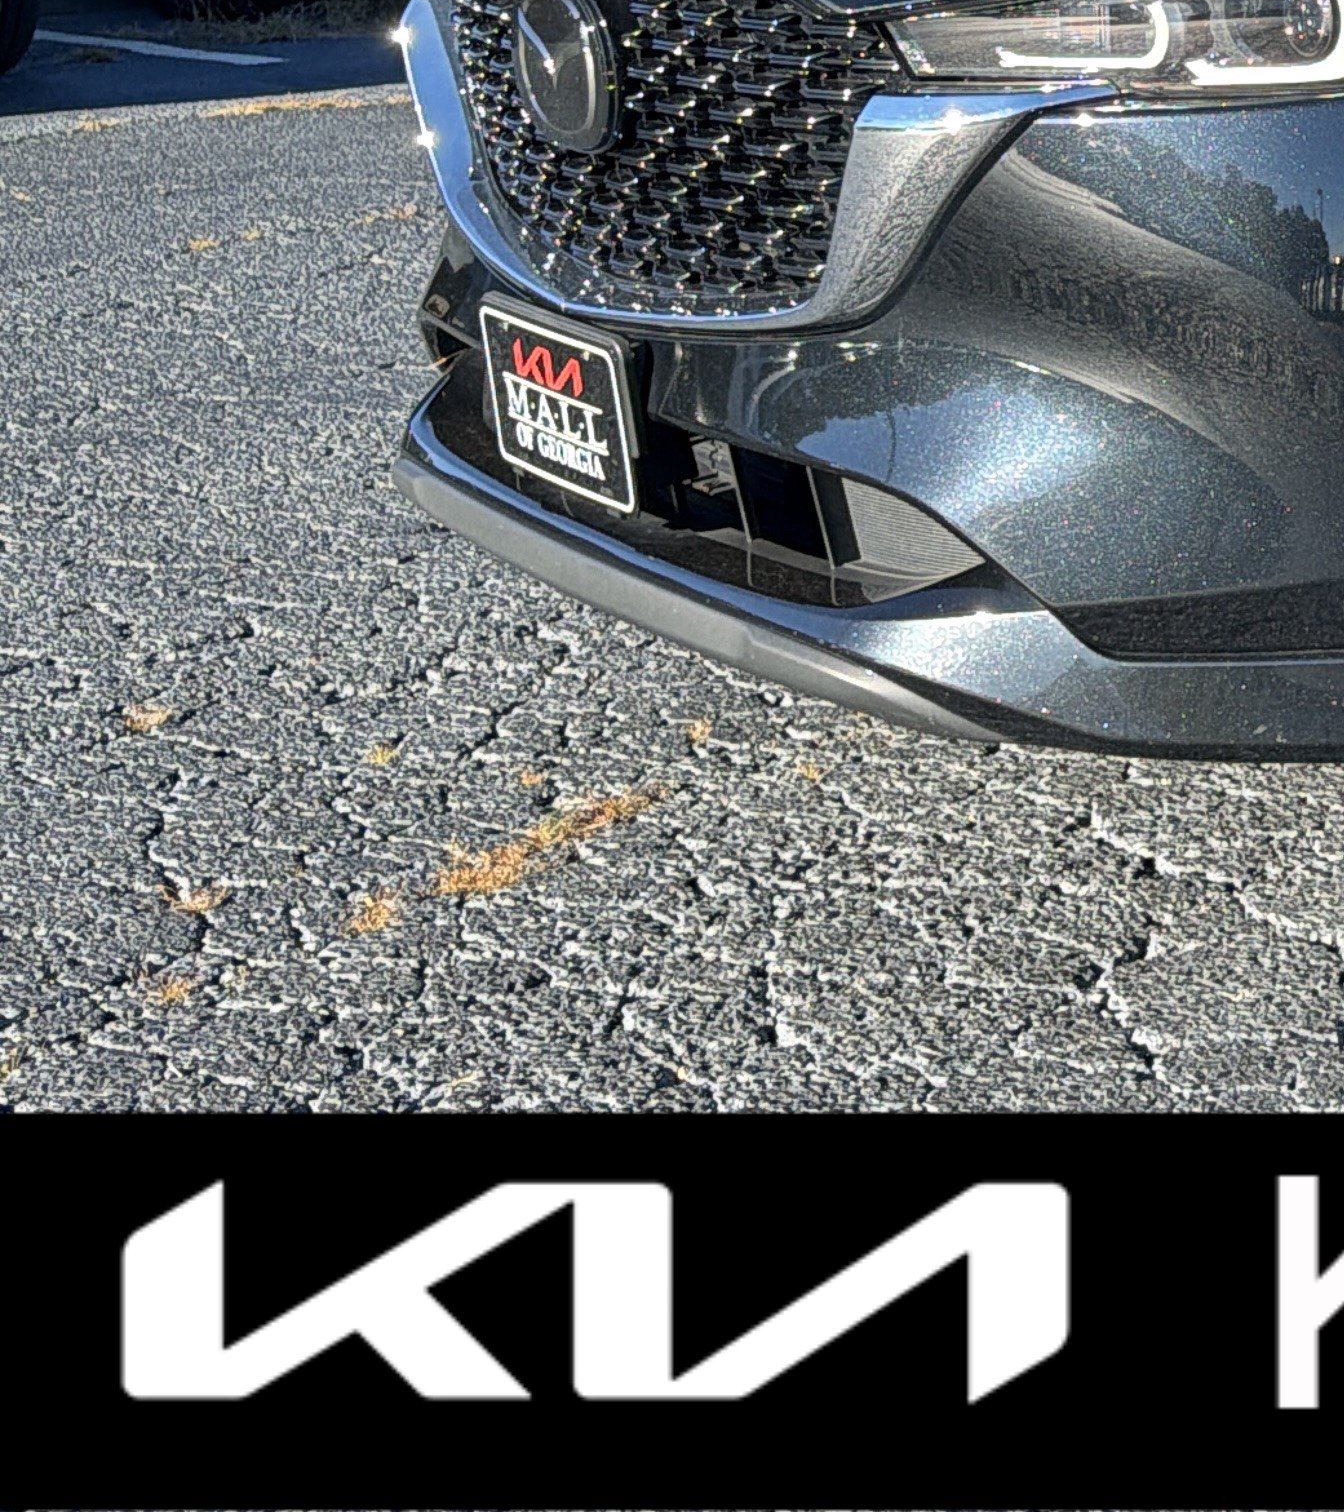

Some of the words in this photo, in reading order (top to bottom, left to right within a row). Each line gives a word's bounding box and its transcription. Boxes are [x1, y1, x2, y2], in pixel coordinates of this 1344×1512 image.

[512, 337, 584, 398] KIA
[516, 421, 534, 451] OF
[537, 436, 606, 481] GEORGIA
